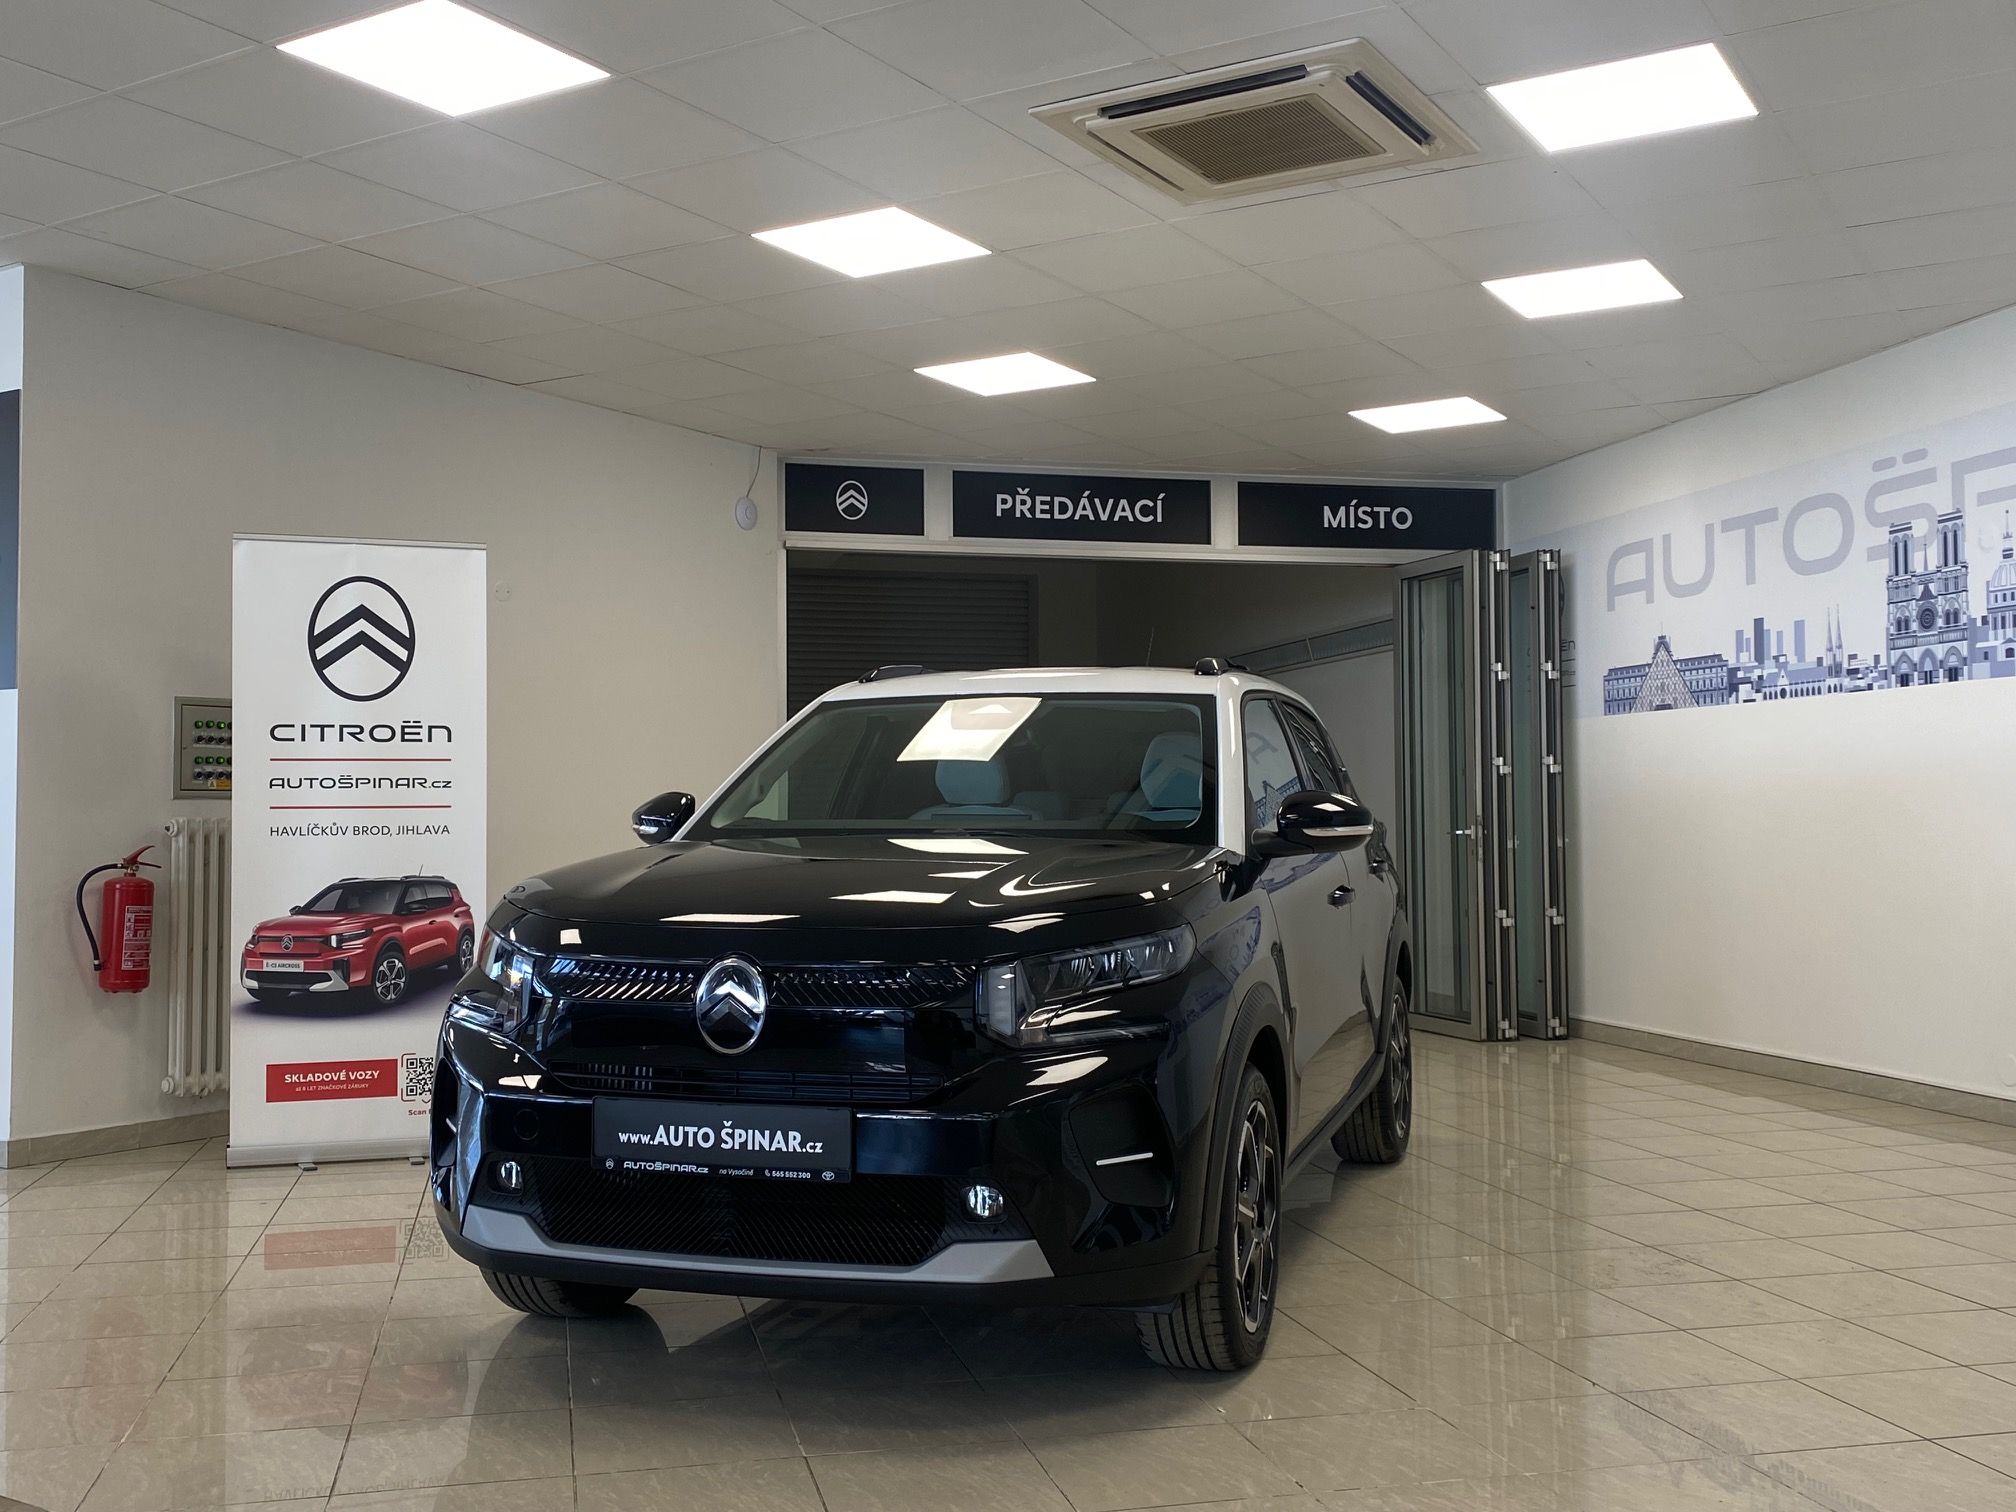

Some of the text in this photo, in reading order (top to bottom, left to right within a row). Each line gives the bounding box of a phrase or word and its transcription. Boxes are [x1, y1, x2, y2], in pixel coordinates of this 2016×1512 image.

[997, 488, 1413, 531] PŘEDÁVACÍ MÍSTO
[270, 823, 450, 837] HAVLÍČKŮV BROD, JIHLAVA
[284, 1070, 380, 1083] SKLADOVÉ VOZY
[618, 1121, 823, 1153] www.AUTO ŠPINAR.cz
